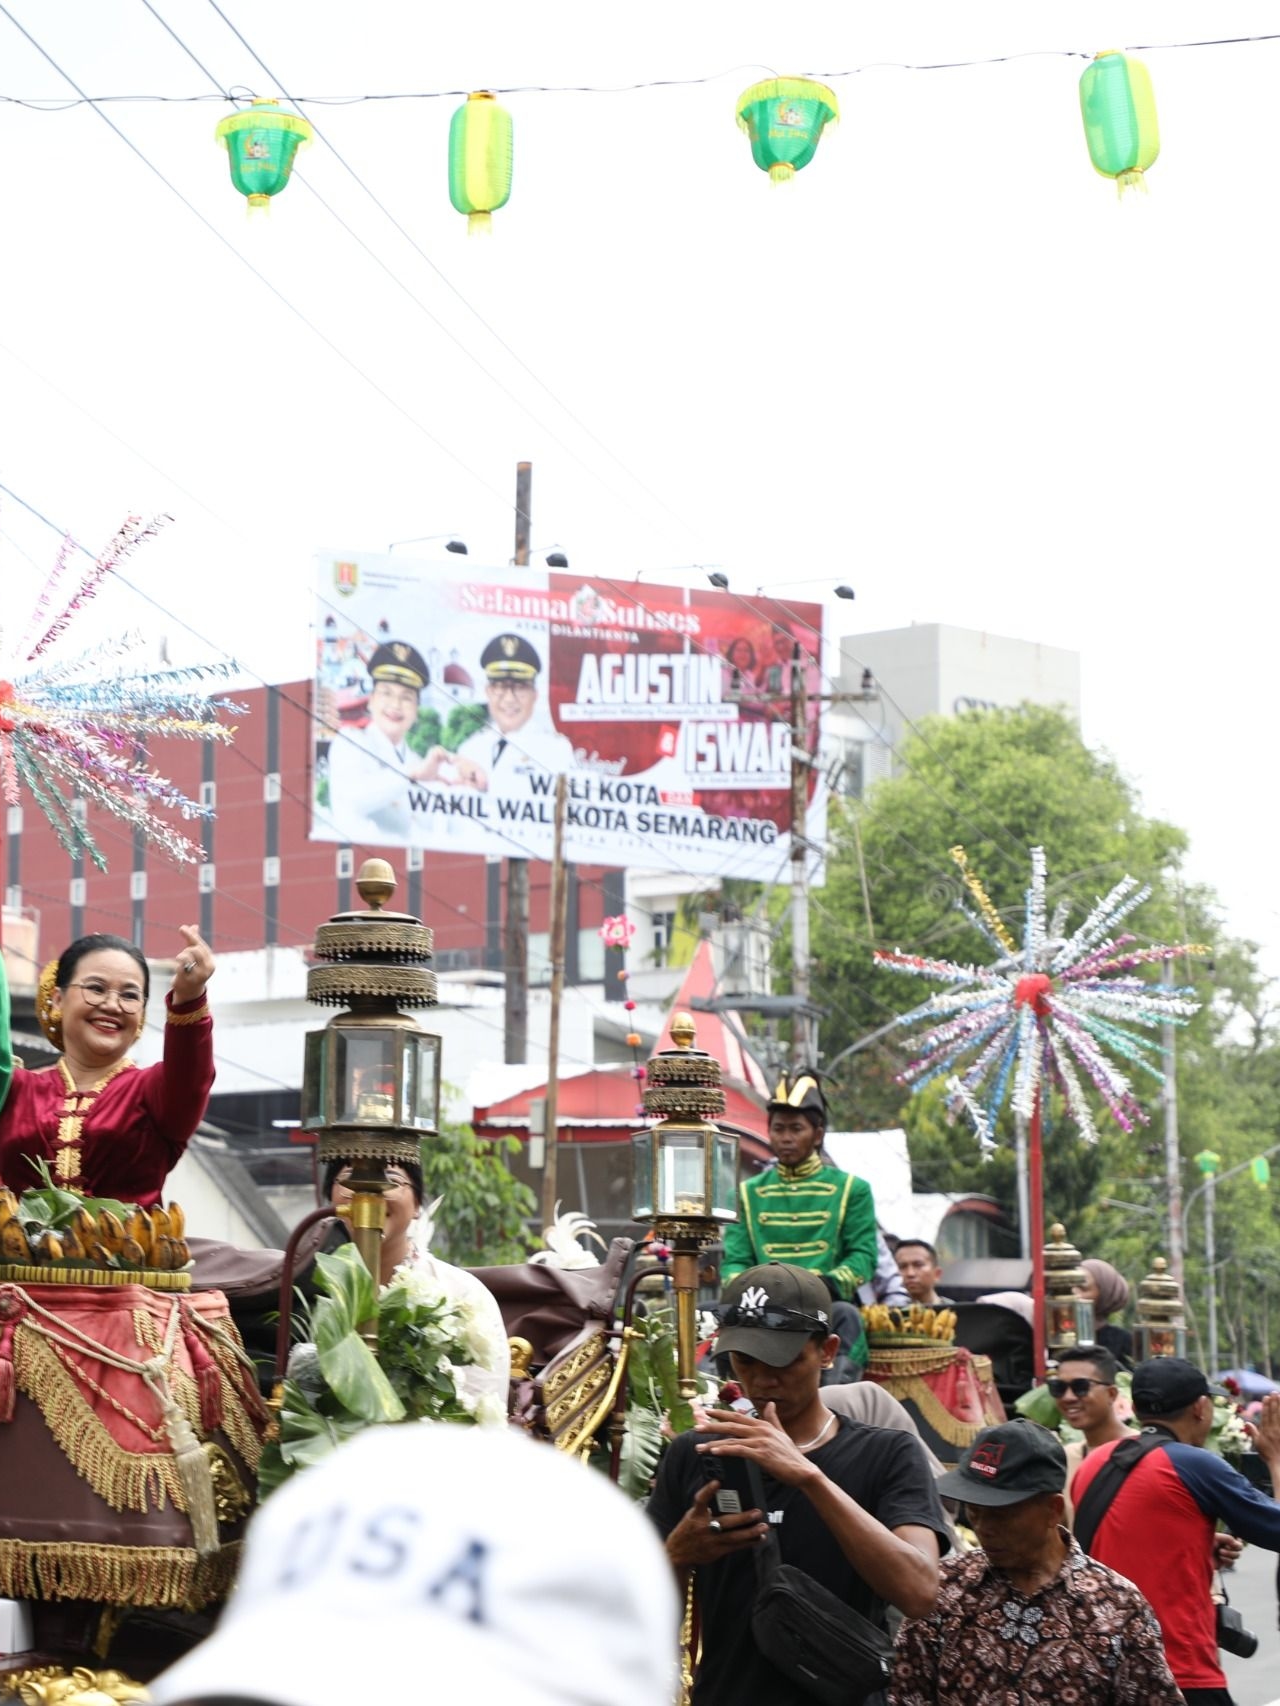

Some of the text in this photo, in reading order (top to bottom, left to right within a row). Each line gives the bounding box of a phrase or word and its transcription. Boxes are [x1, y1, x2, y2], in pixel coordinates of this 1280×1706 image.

[574, 653, 723, 705] AGUSTIN
[683, 721, 792, 774] ISWAR
[529, 773, 660, 807] WLI KOTA
[408, 789, 489, 819] WAKIL
[567, 804, 630, 833] KOTA
[636, 811, 776, 845] SEMARANG
[275, 1502, 488, 1626] USA
